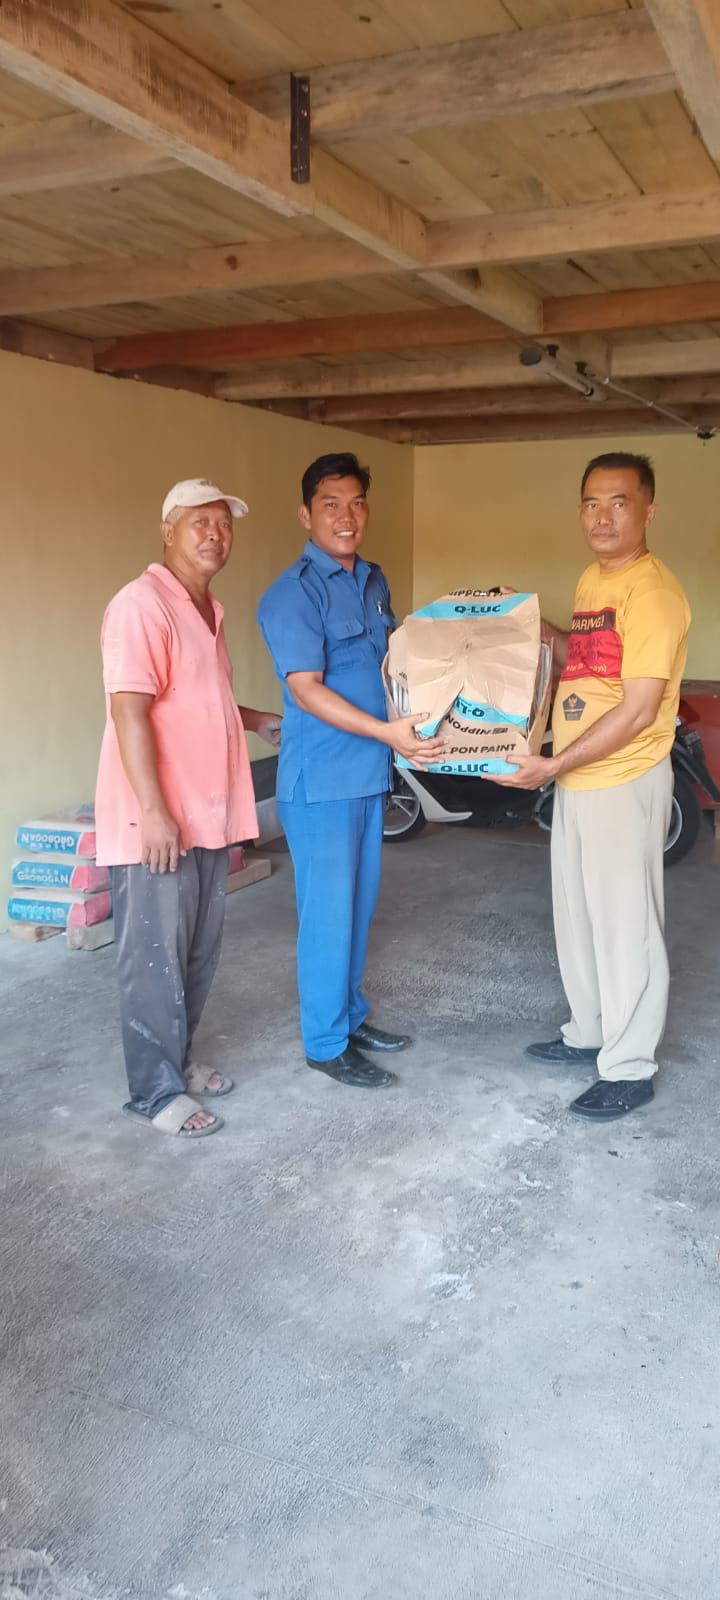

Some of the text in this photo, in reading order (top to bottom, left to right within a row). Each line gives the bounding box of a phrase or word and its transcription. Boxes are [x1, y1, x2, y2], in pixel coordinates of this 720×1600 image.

[454, 604, 501, 614] Q-LUC
[444, 714, 491, 736] NIPPON
[480, 743, 517, 753] PAINT
[440, 763, 489, 773] Q-LUC
[17, 871, 68, 884] GROBOGAN
